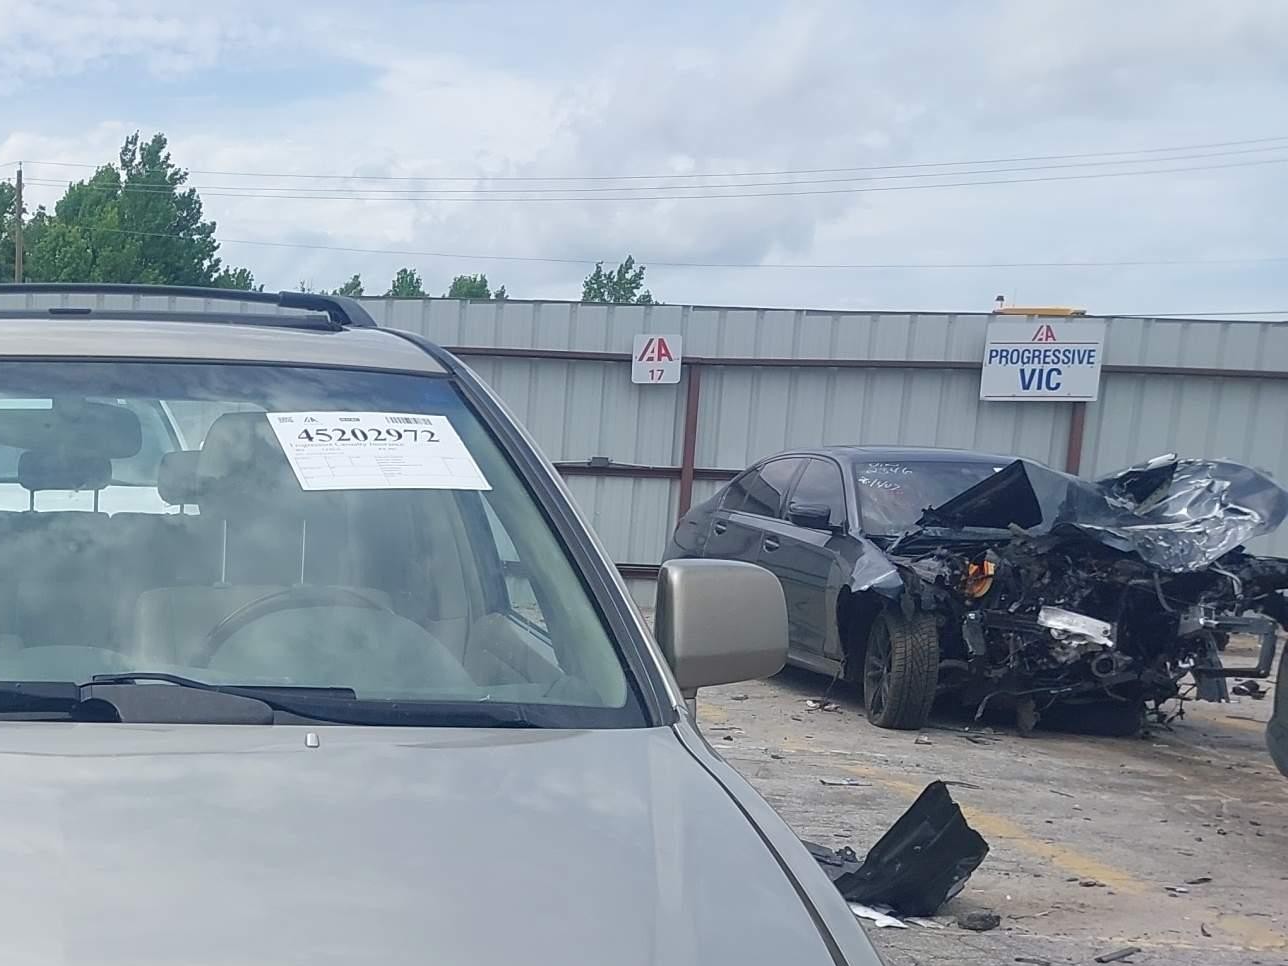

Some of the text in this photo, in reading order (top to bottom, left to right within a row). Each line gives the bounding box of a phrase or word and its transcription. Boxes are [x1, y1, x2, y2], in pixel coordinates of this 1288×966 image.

[988, 348, 1097, 366] PROGRESSIVE
[648, 368, 665, 381] 17
[1019, 367, 1062, 391] VIC
[297, 427, 441, 443] 45202972
